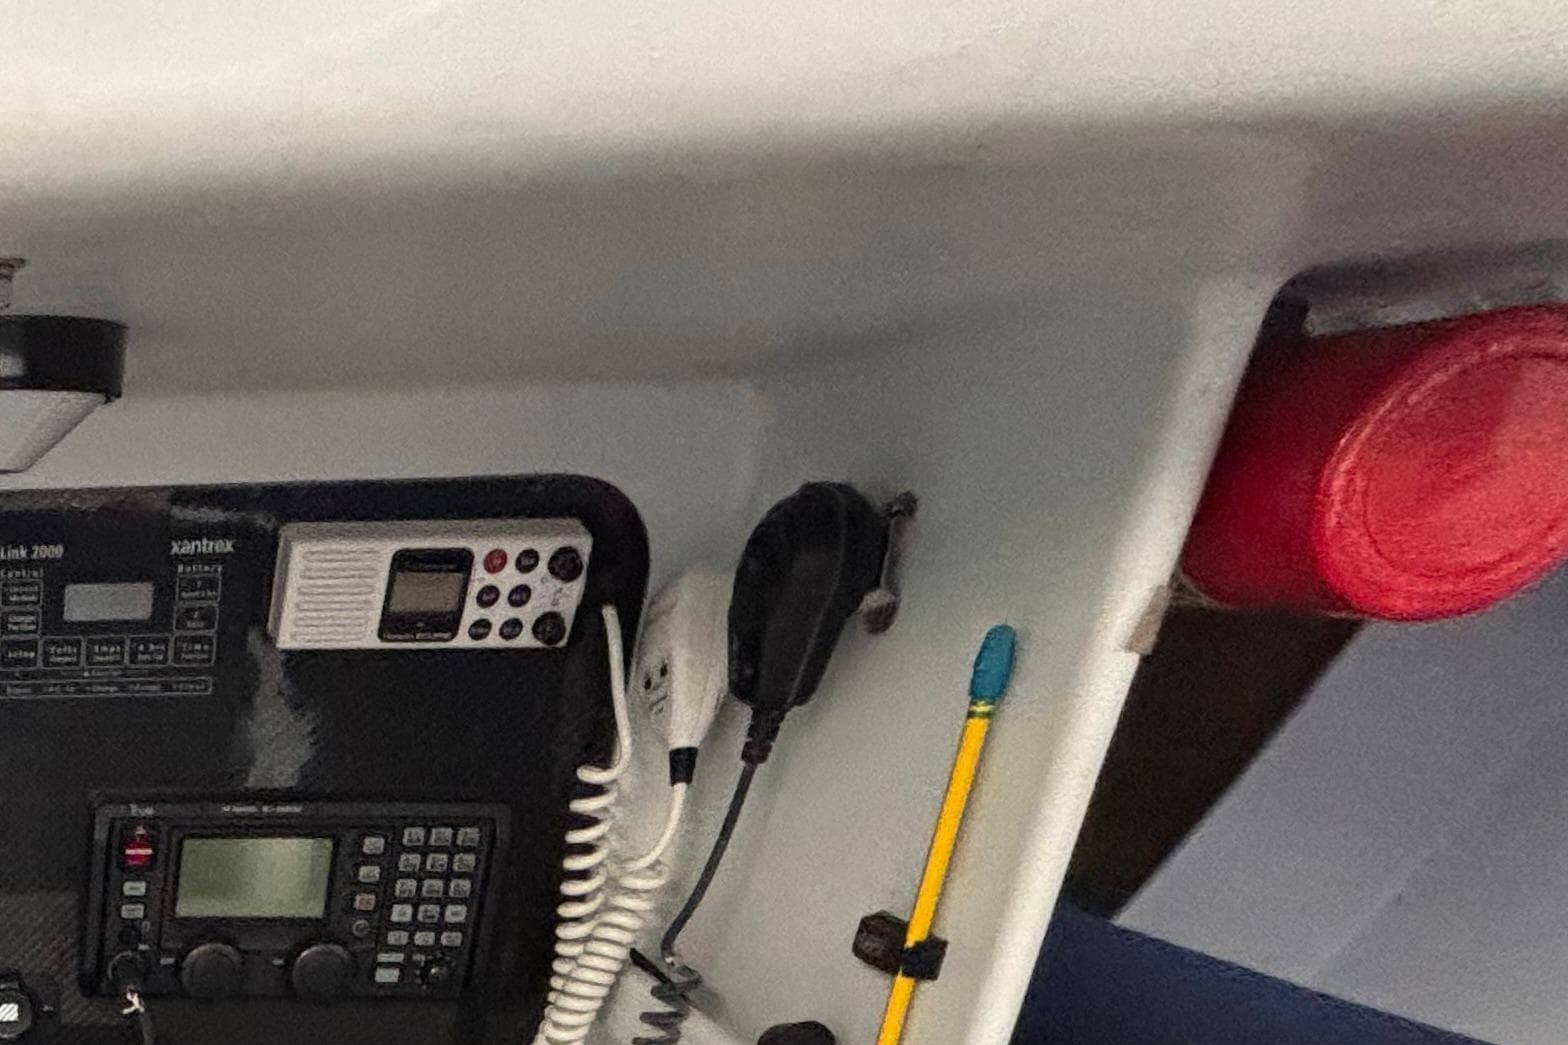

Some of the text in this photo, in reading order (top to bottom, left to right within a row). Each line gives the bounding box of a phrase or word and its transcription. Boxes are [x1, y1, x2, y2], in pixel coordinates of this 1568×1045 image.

[0, 543, 64, 560] Link 2000
[170, 538, 234, 555] xantrex
